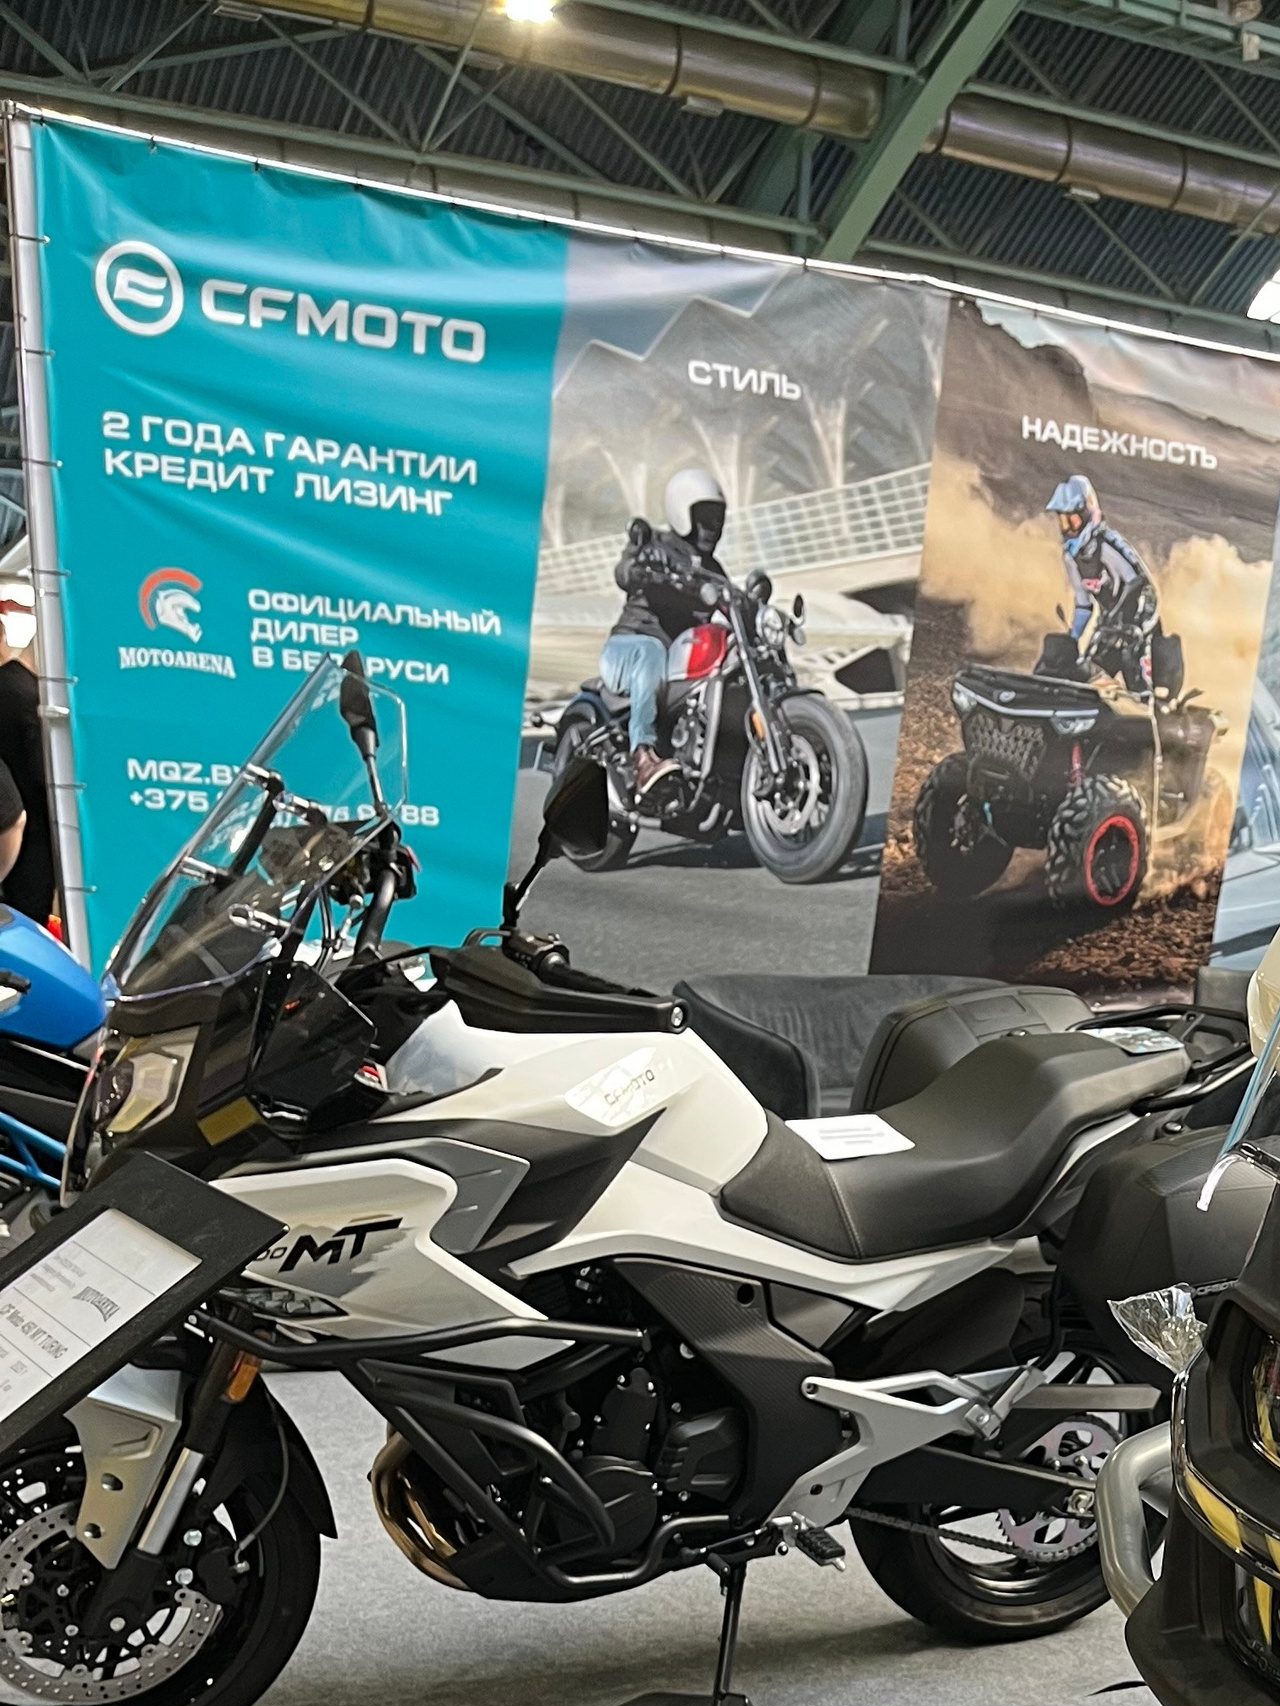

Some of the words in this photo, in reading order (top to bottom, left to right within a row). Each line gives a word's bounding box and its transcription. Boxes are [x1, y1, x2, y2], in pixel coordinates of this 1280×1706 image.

[201, 280, 486, 363] CFMOTO
[687, 360, 803, 401] СТИЛЬ
[103, 411, 131, 439] 2
[142, 415, 255, 456] ГОДА
[264, 432, 478, 486] ГАРАНТИИ
[1021, 414, 1218, 470] НАДЕЖНОСТЬ
[105, 449, 274, 496] КРЕДИТ
[295, 472, 453, 516] ЛИЗИНГ
[248, 588, 502, 637] ОФИЦИАЛЬНЫЙ
[251, 617, 359, 647] ДИЛЕР
[118, 646, 236, 679] MOTOARENA
[252, 646, 274, 668] В
[129, 788, 209, 812] +375
